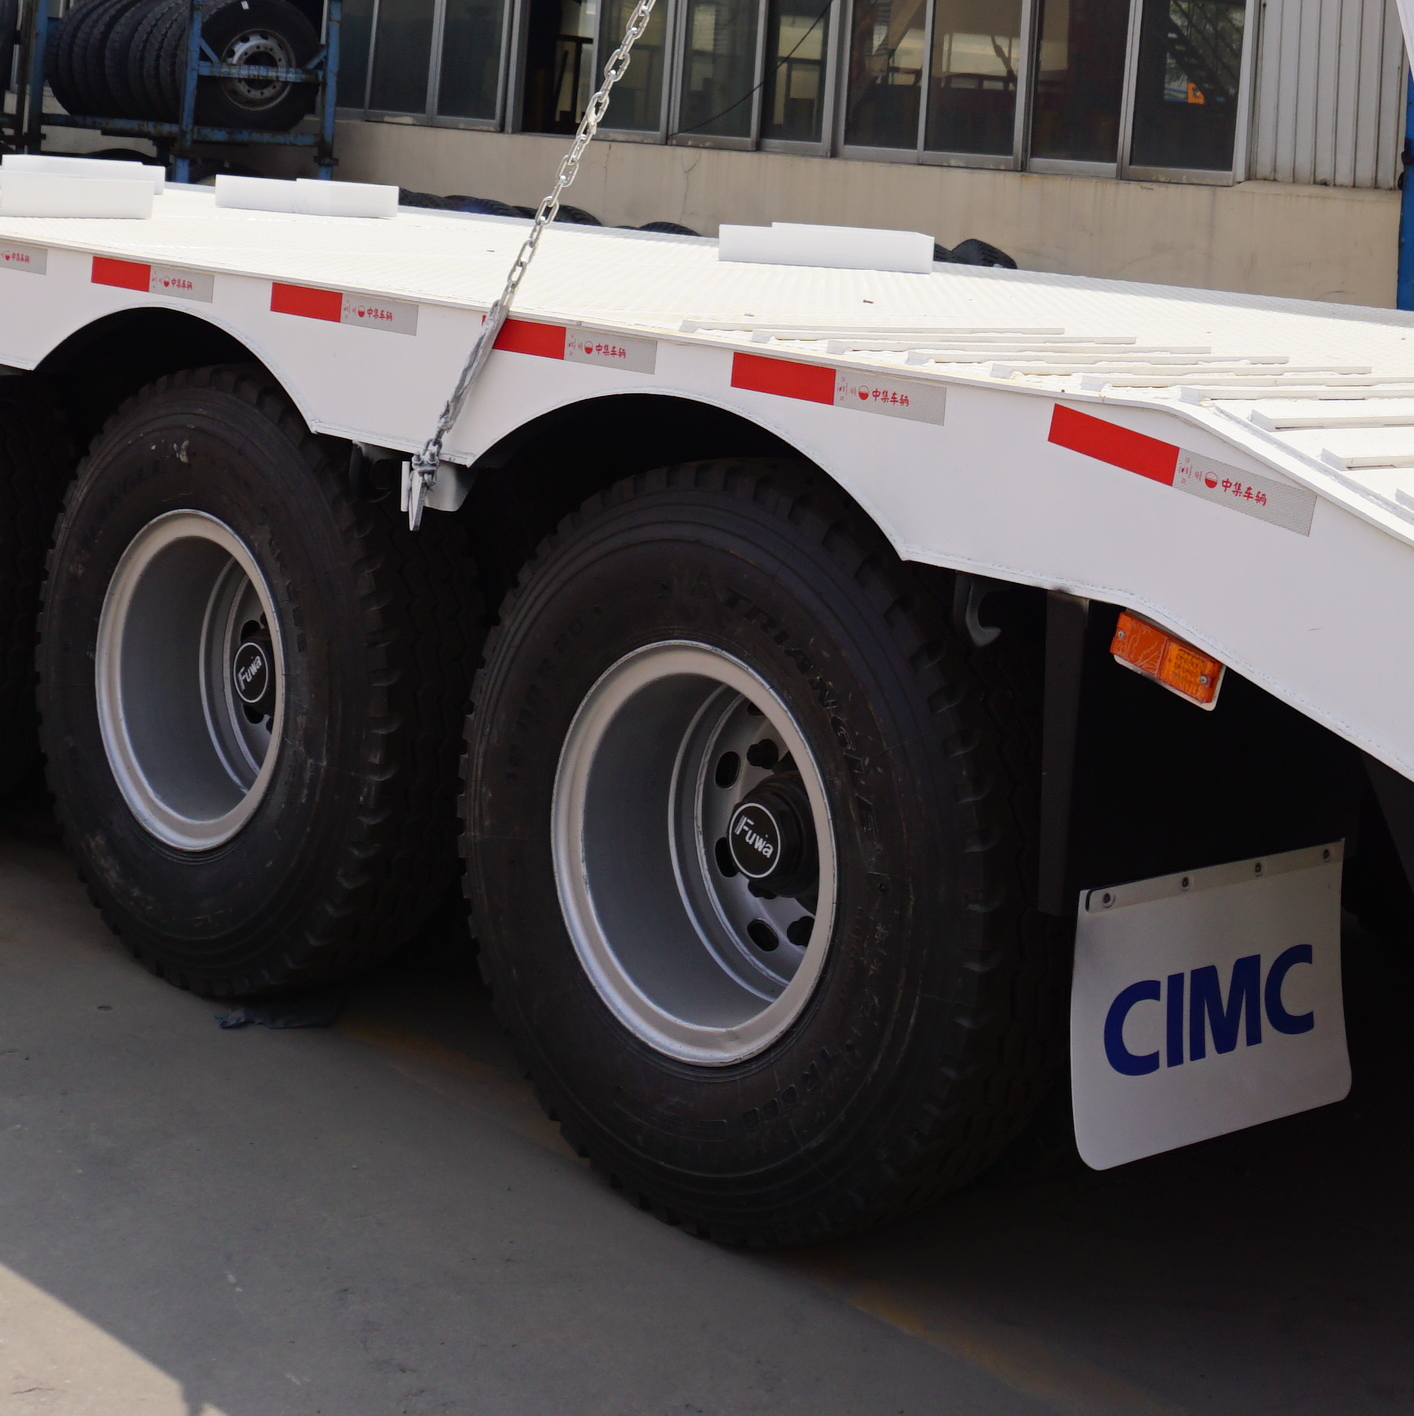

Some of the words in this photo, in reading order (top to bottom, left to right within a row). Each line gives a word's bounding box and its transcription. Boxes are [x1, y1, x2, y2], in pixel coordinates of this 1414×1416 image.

[595, 343, 626, 359] 中集车辆
[872, 388, 910, 407] 中集车辆
[1221, 478, 1267, 506] 中集车辆
[238, 655, 262, 691] Fuwa
[734, 815, 774, 858] Fuwa
[1104, 944, 1315, 1076] CIMC
